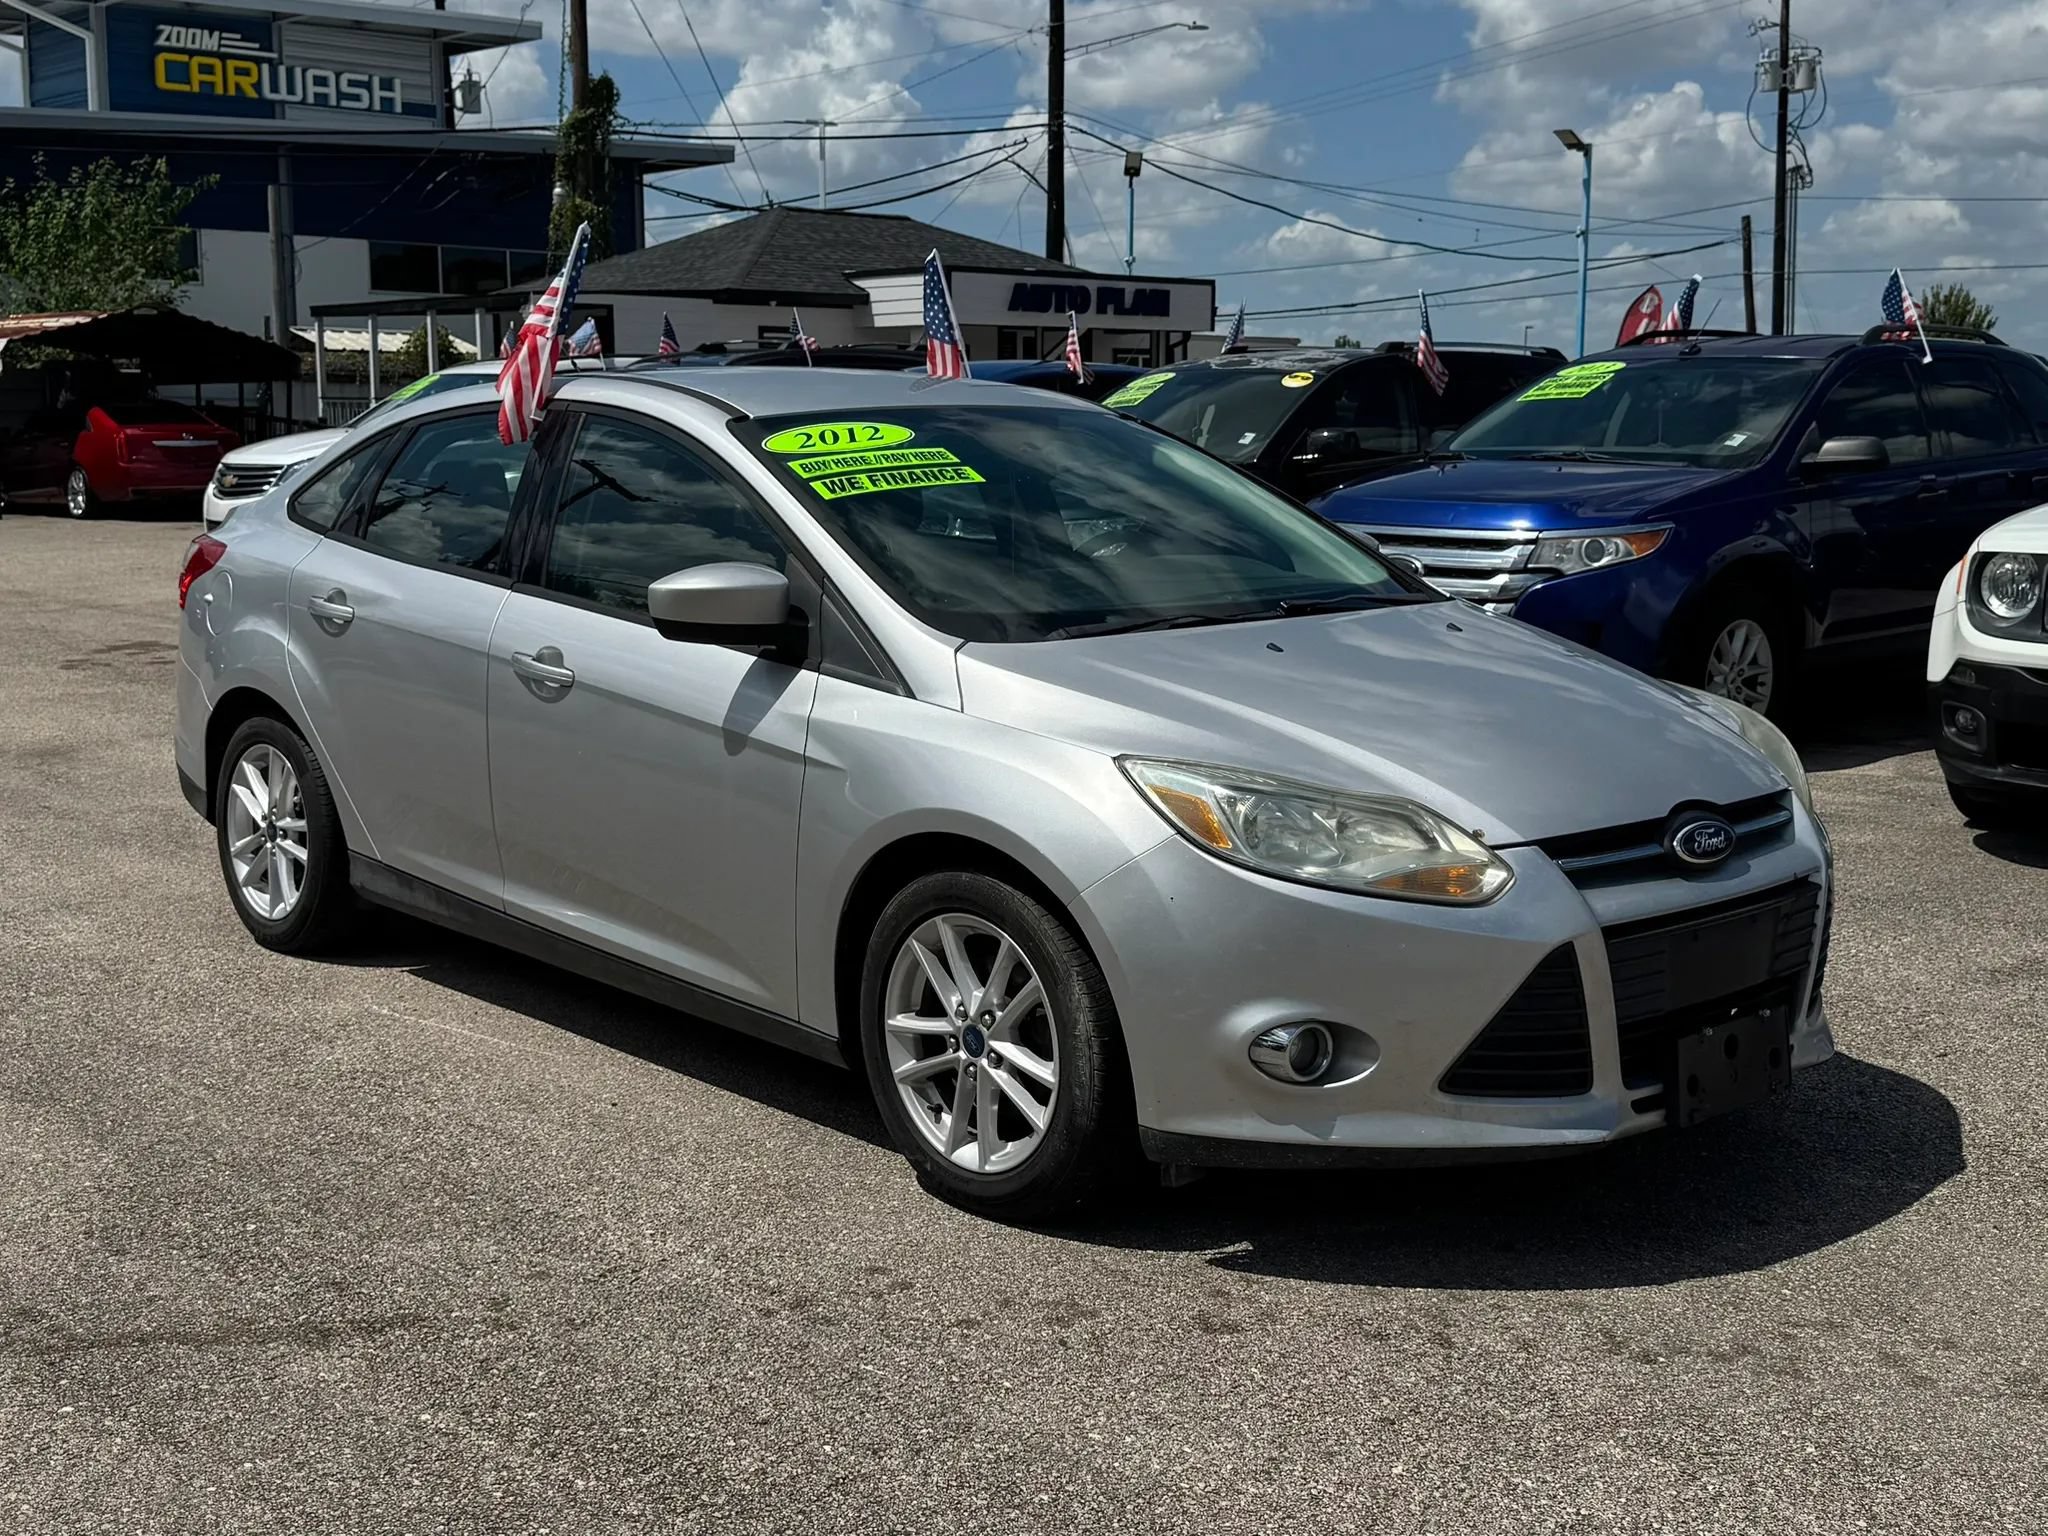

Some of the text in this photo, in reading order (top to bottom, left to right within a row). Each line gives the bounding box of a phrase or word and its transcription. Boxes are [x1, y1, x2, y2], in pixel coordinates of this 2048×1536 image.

[154, 24, 220, 51] ZOOM
[1008, 282, 1171, 317] AUTO PLAN
[794, 425, 885, 449] 2012
[801, 459, 830, 474] BUY
[833, 454, 871, 469] HERE
[885, 451, 910, 465] PAY
[912, 449, 948, 462] HERE
[821, 466, 972, 496] WE FINANCE
[1694, 827, 1727, 854] Ford
